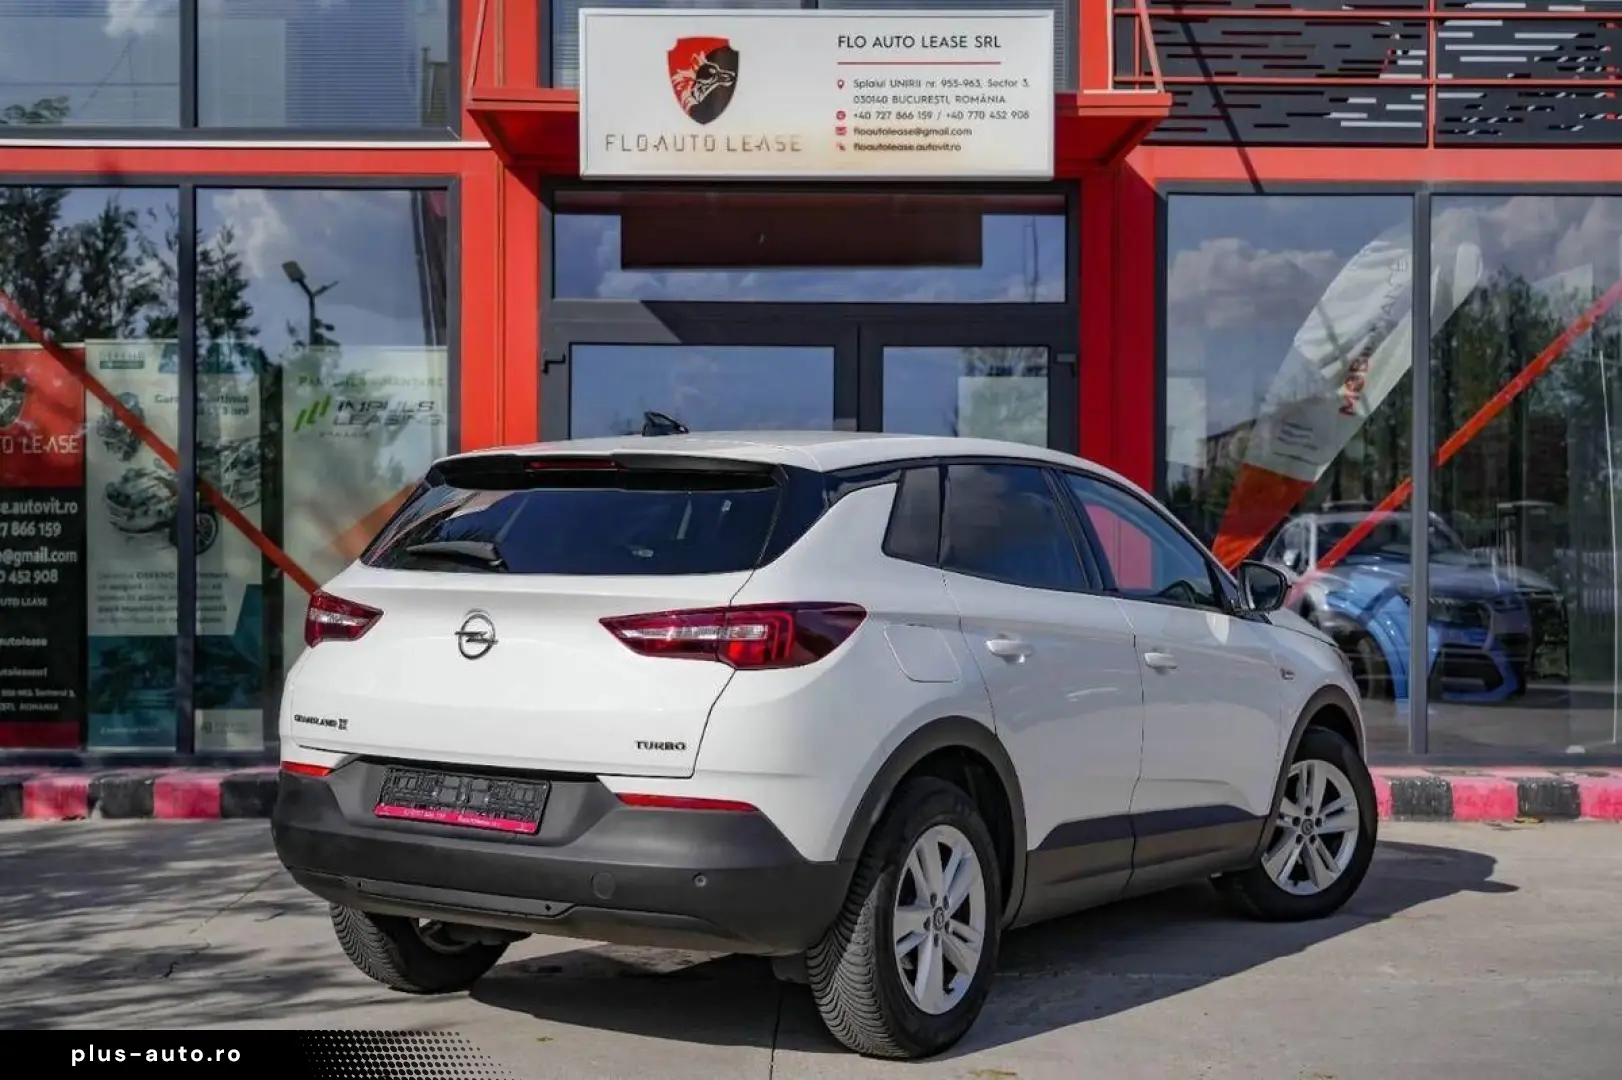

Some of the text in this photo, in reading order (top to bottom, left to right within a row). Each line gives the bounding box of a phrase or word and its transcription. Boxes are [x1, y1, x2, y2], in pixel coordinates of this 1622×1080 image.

[837, 35, 1002, 48] FLO AUTO LEASE SRL
[853, 78, 886, 90] Splaiul
[890, 79, 921, 88] UNIRII
[987, 78, 1018, 89] Sector
[853, 110, 871, 120] +40
[875, 110, 892, 120] 727
[896, 110, 914, 120] 866
[918, 110, 933, 120] 159
[946, 110, 963, 120] +40
[968, 110, 985, 120] 770
[989, 110, 1007, 120] 452
[853, 126, 973, 138] floautolease@gmail.com
[726, 133, 803, 153] LEASE
[853, 142, 962, 152] floautolease.autovit.ro
[22, 435, 80, 454] LEASE
[11, 521, 36, 538] 866
[38, 521, 62, 538] 159
[0, 546, 78, 567] @gmail.com
[8, 569, 31, 585] 452
[33, 569, 59, 585] 908
[636, 740, 687, 751] TURBO
